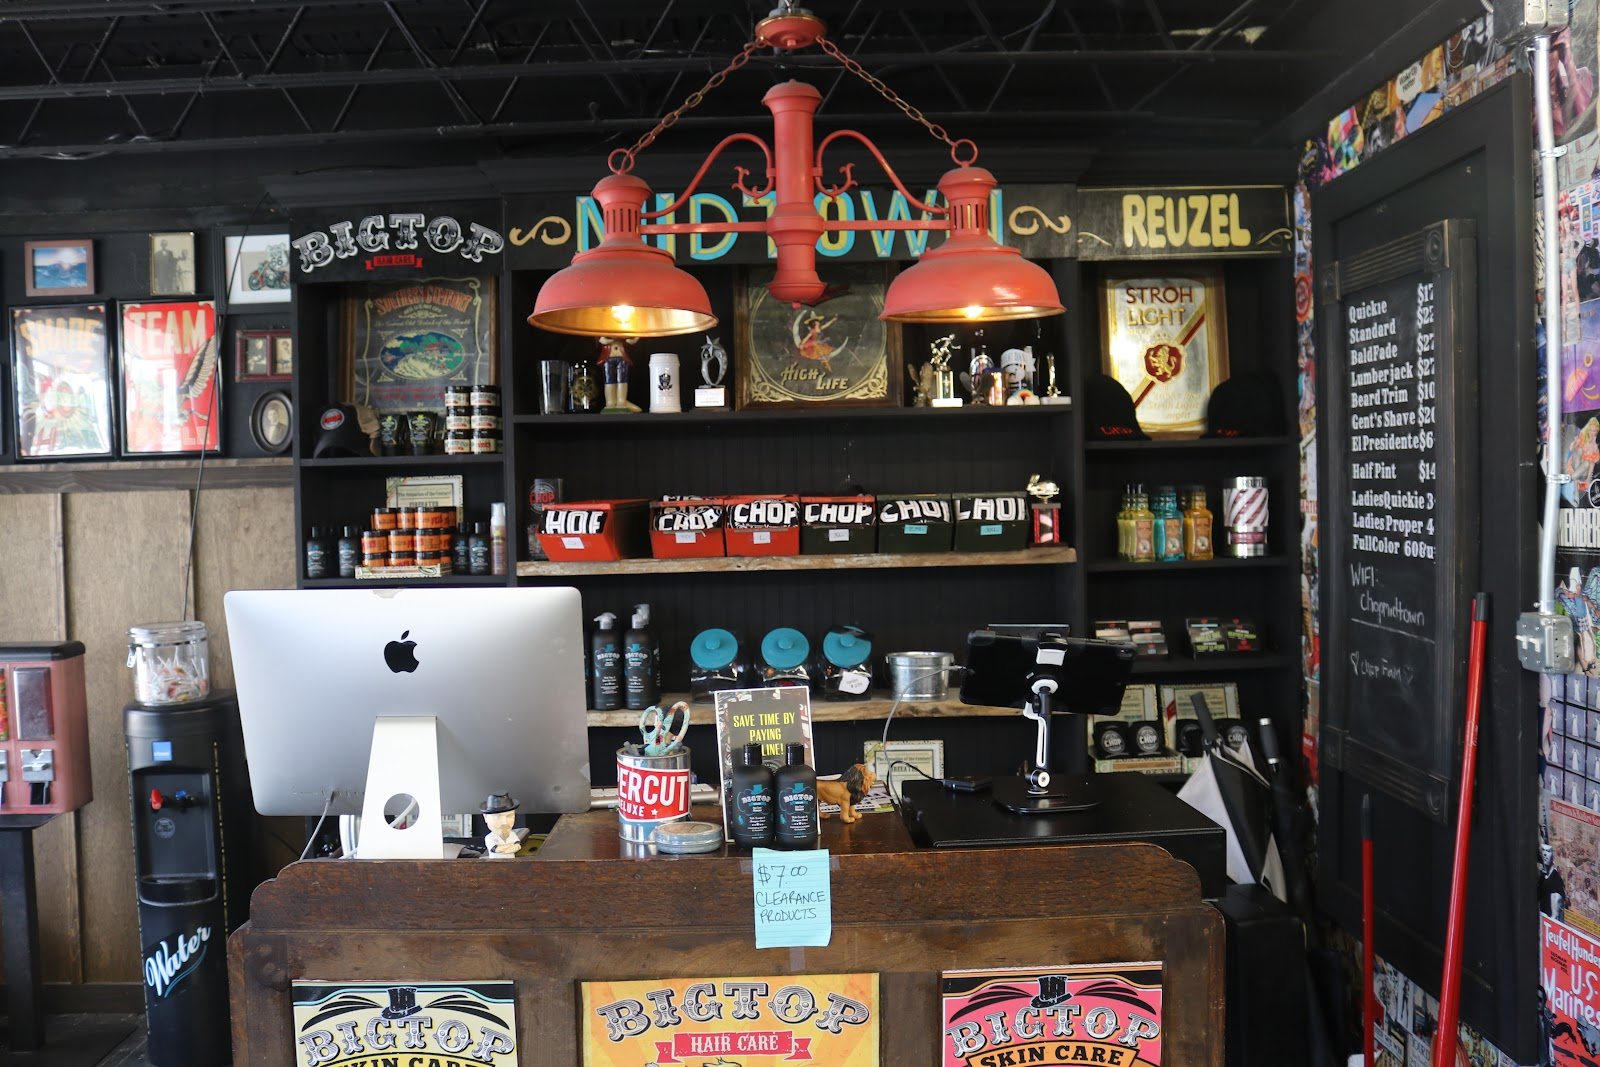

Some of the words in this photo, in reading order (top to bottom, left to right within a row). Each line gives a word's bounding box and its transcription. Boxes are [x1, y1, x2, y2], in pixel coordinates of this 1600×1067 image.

[577, 188, 1004, 261] MIDTOW
[1122, 193, 1251, 248] REUZEL
[292, 213, 504, 273] BIGTOP
[1126, 286, 1193, 304] STROH
[1126, 308, 1185, 326] LIGHT
[1349, 300, 1388, 323] Quickie
[130, 310, 206, 355] TEAM
[1349, 318, 1396, 344] Standard
[1350, 342, 1398, 365] BaldFade
[781, 361, 819, 384] HIGH
[816, 372, 849, 390] LIFE
[1351, 362, 1413, 387] Lumberjack
[1351, 389, 1381, 408] Beard
[1381, 386, 1408, 403] Trim
[1351, 413, 1382, 430] Gent's
[1383, 410, 1416, 428] Shave
[1352, 435, 1361, 452] El
[1363, 433, 1420, 451] Presidente
[1419, 428, 1435, 452] $6
[1352, 462, 1374, 479] Half
[1375, 462, 1397, 479] Pint
[1418, 459, 1436, 483] $14
[1426, 492, 1436, 510] 3
[541, 510, 604, 534] HOP
[658, 508, 720, 531] CHOP
[734, 503, 798, 525] CHOP
[804, 503, 873, 524] CHOP
[1353, 511, 1385, 531] Ladies
[1385, 514, 1423, 538] Proper
[1353, 533, 1400, 555] FullColor
[1404, 540, 1436, 559] 60&u
[733, 714, 755, 727] SAVE
[758, 712, 780, 726] TIME
[783, 711, 796, 724] BY
[749, 728, 782, 742] PAYING
[1139, 733, 1158, 745] CHOP
[1227, 733, 1244, 743] CHO
[761, 743, 784, 757] LINE!
[619, 797, 645, 817] ELUXE
[741, 794, 772, 804] BIGTOP
[783, 793, 814, 803] BIGTOP
[756, 890, 826, 908] CLEARANCE
[760, 908, 817, 924] PRODUCTS
[1543, 921, 1571, 955] Teufel
[145, 926, 212, 997] Water
[1571, 964, 1599, 1001] U.S.
[1543, 967, 1600, 1029] Marines
[597, 983, 870, 1042] BIGTOP
[299, 1016, 515, 1067] BIGTOP
[945, 1004, 1161, 1058] BIGTOP
[691, 1035, 731, 1053] HAIR
[736, 1034, 779, 1051] CARE
[339, 1057, 399, 1067] KIN
[980, 1046, 1046, 1067] SKIN
[1054, 1044, 1125, 1065] CARE
